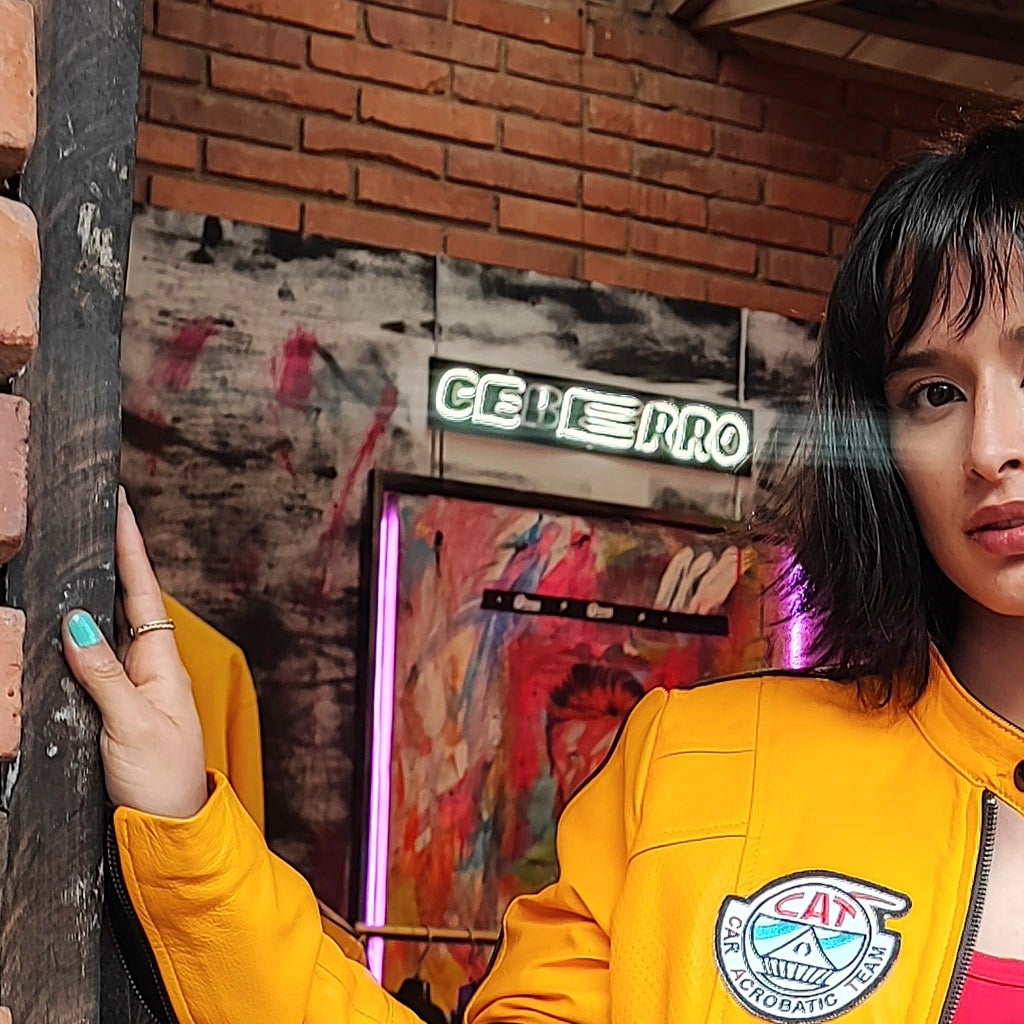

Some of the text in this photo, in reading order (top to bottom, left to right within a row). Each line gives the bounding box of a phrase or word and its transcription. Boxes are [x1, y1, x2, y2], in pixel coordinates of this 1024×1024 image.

[774, 891, 857, 928] CAT
[722, 915, 888, 1014] CAR ACROBATIC TEAM
